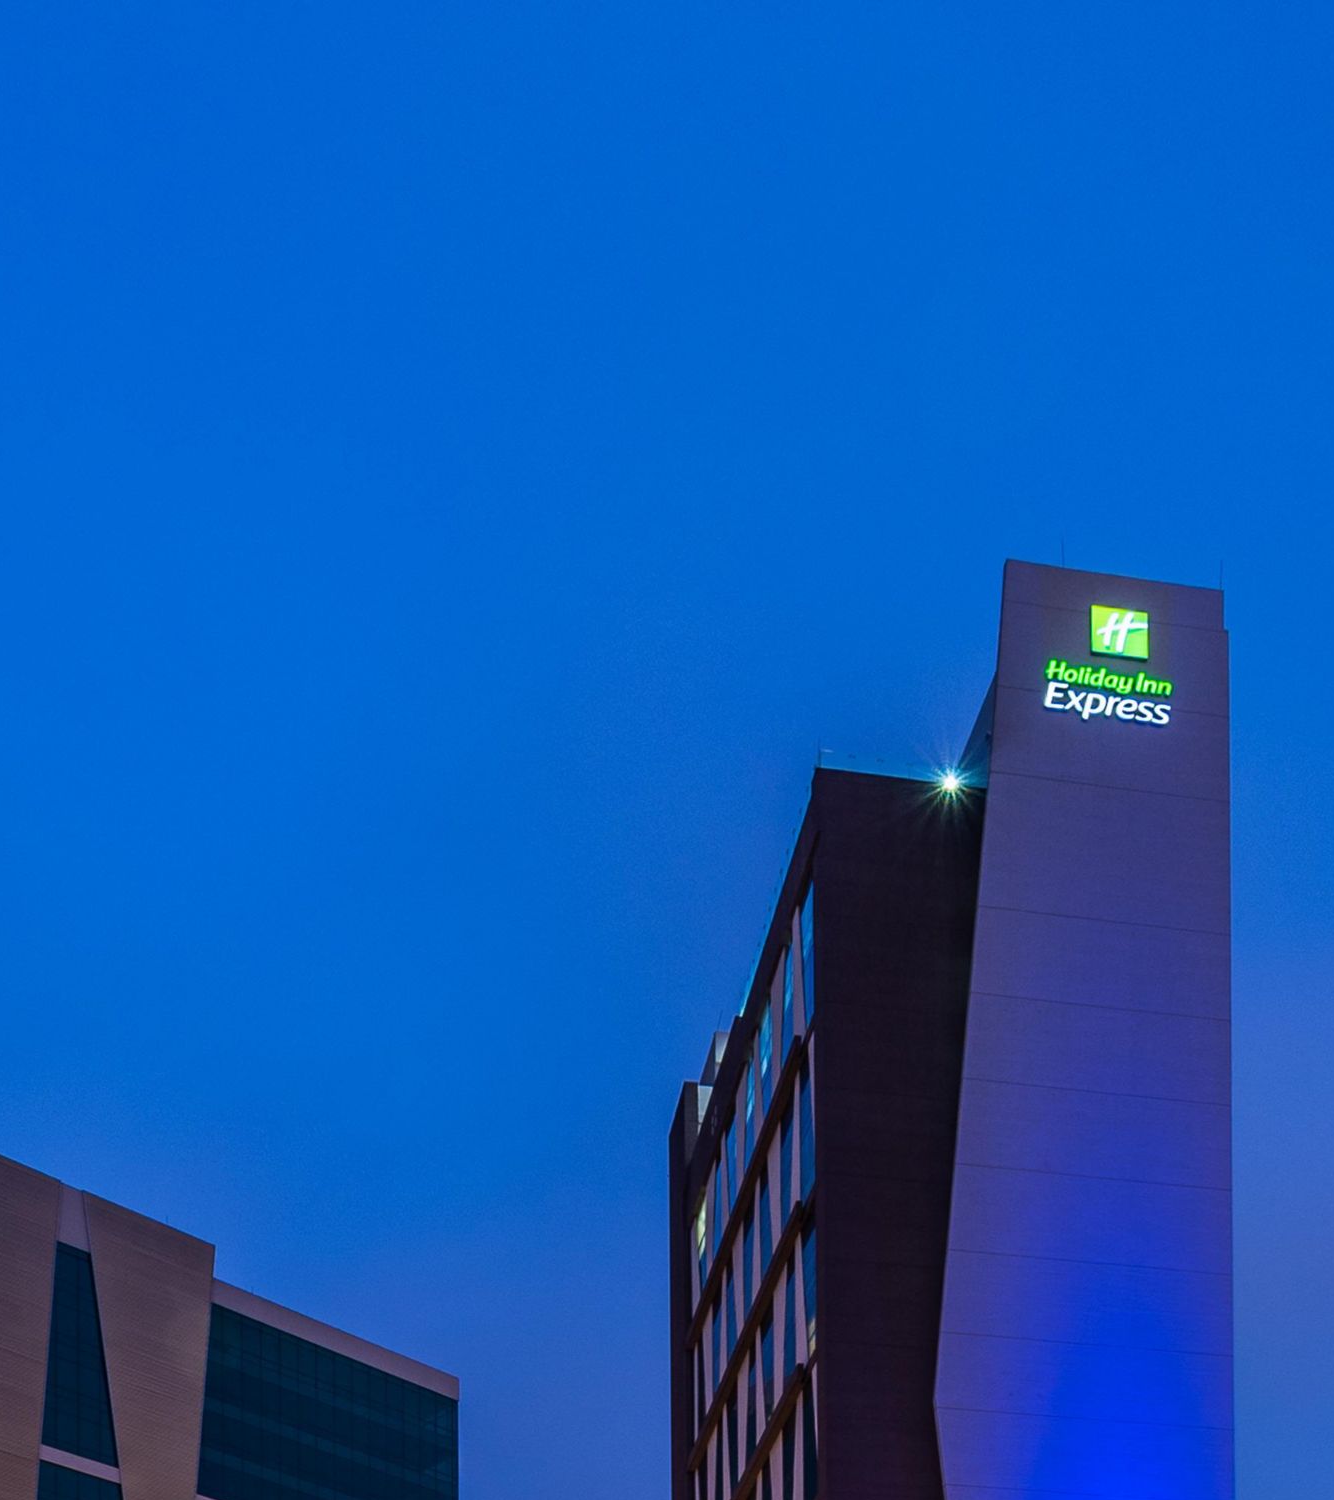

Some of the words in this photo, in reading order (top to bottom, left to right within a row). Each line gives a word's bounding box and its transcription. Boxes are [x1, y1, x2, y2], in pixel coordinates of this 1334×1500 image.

[1046, 660, 1133, 695] Holiday
[1135, 672, 1172, 696] Inn
[1043, 681, 1172, 725] Express
